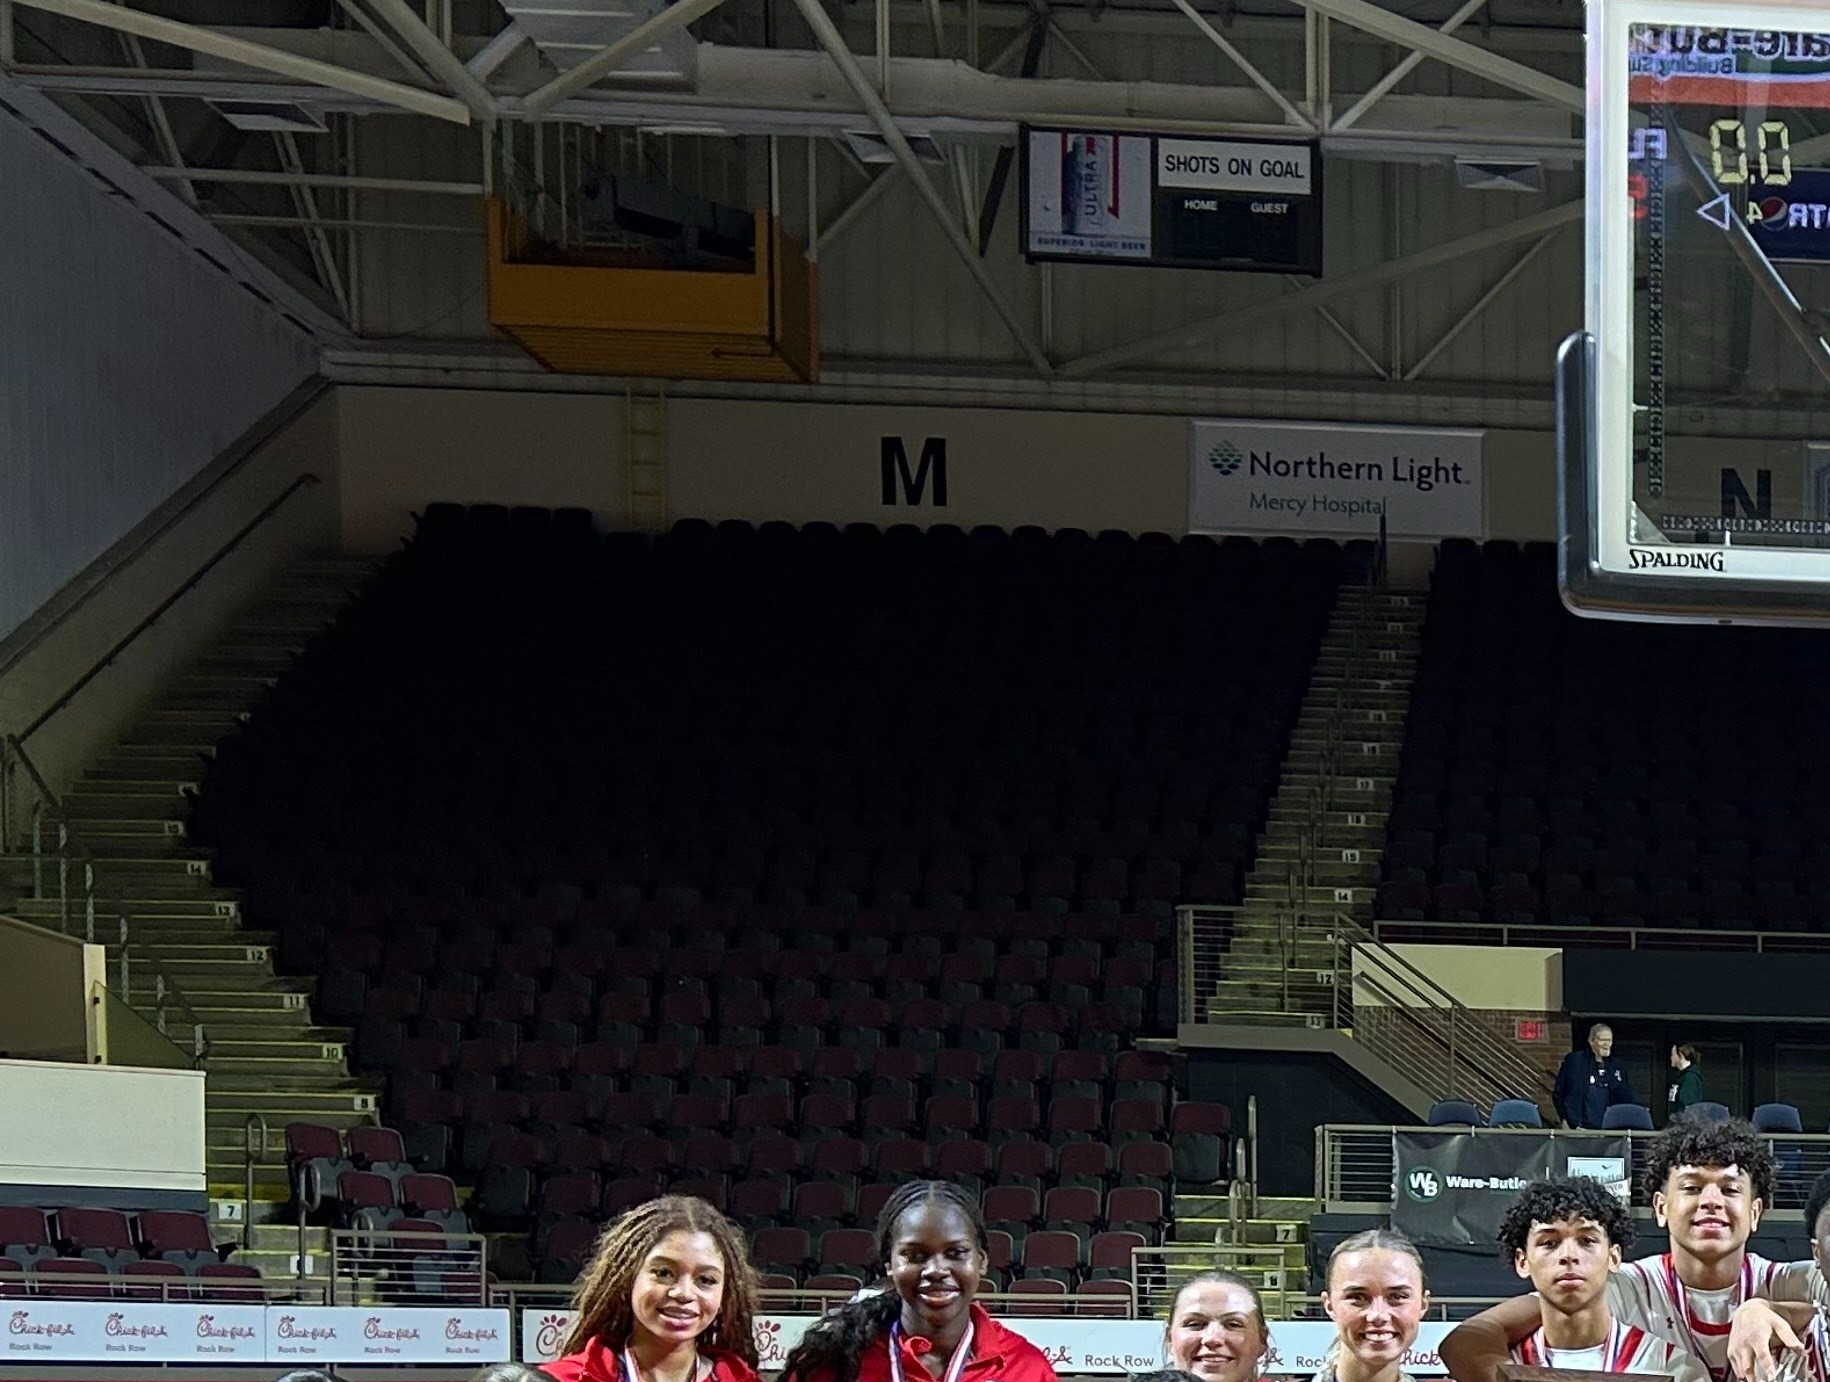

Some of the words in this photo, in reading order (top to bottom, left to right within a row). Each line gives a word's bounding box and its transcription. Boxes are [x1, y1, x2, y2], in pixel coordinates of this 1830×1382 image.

[1164, 153, 1220, 175] SHOTS
[1227, 157, 1252, 176] ON
[1260, 159, 1305, 179] GOAL
[1084, 160, 1098, 217] ULTRA
[1184, 199, 1218, 212] HOME
[1250, 202, 1288, 215] GUEST
[881, 436, 947, 507] M
[1250, 449, 1383, 481] Northern
[1392, 456, 1463, 492] Light
[1249, 491, 1306, 517] Mercy
[1312, 495, 1387, 518] Hospital
[1720, 467, 1772, 524] N
[1628, 548, 1725, 572] SPALDING
[1085, 1353, 1120, 1367] Rock
[1124, 1354, 1155, 1367] Row
